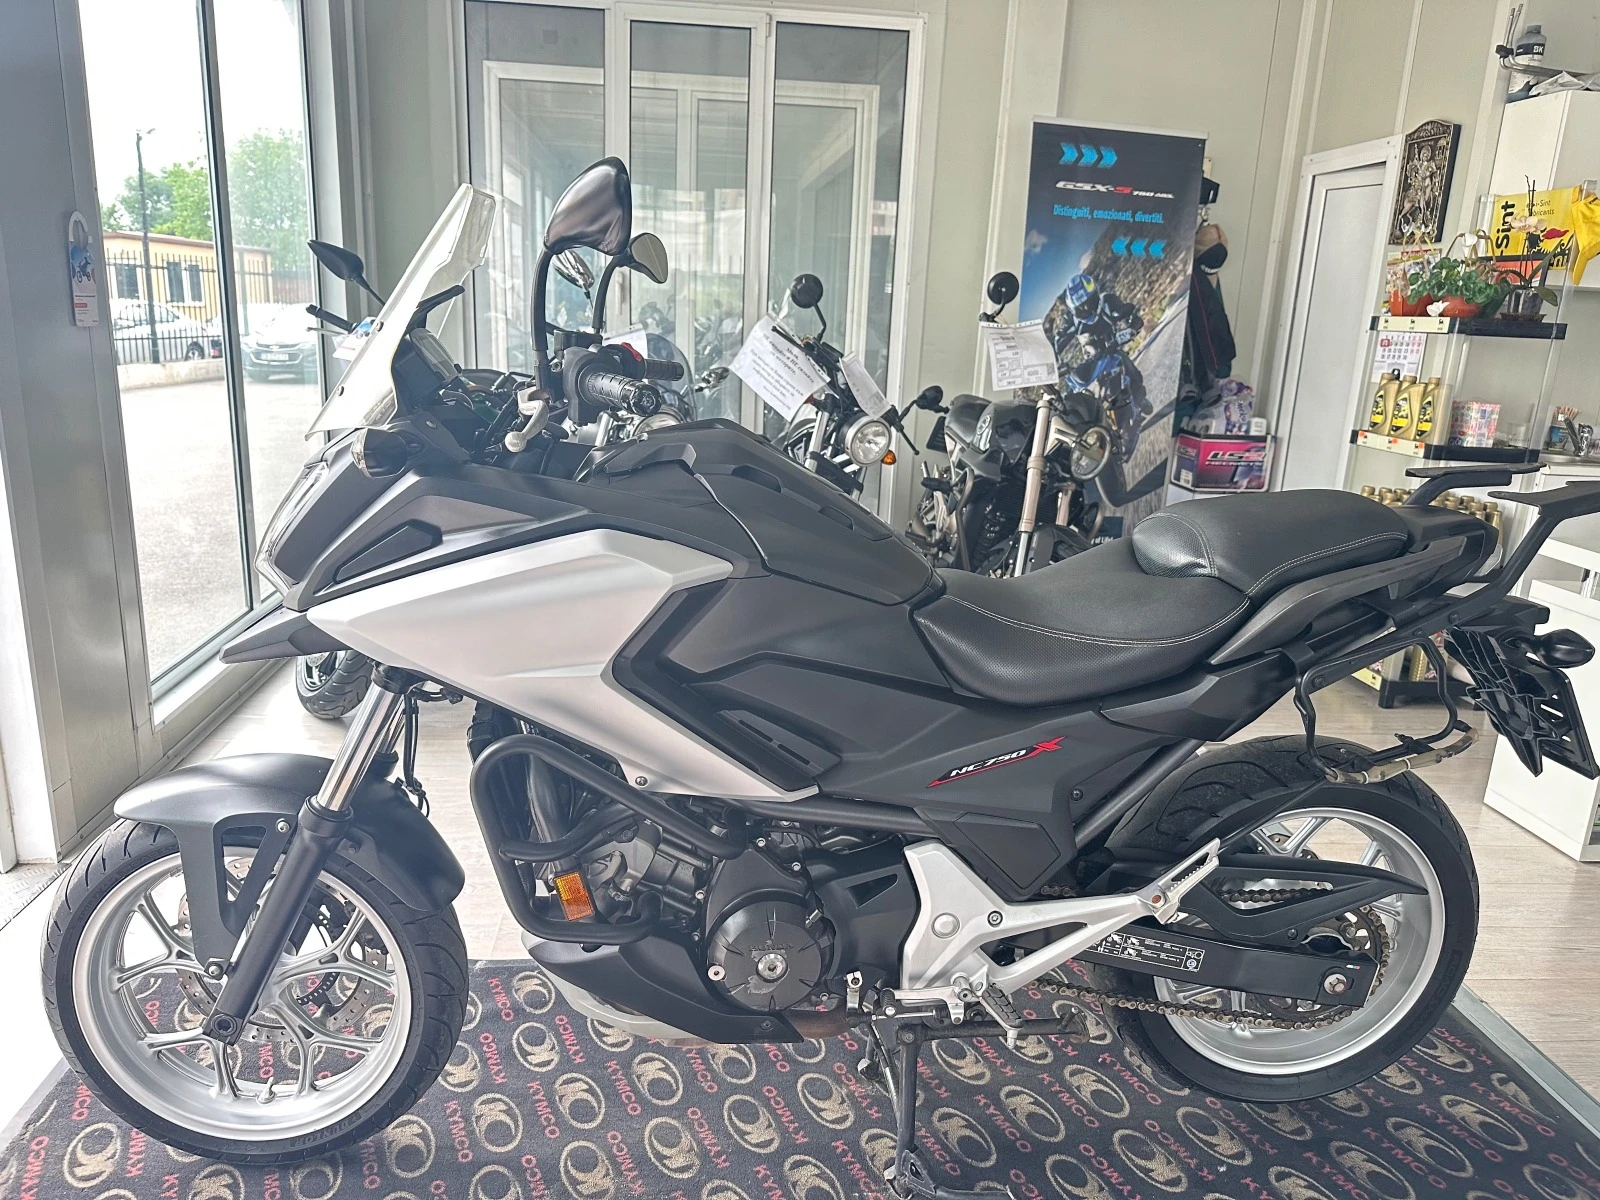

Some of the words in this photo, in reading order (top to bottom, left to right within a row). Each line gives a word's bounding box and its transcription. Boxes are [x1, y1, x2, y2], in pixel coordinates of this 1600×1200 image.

[1056, 181, 1133, 194] GSX-S
[1053, 204, 1092, 219] Distinguiti,
[1093, 209, 1133, 222] emozionati,
[1134, 211, 1164, 224] divertiti.
[1207, 451, 1264, 460] LS2
[950, 749, 1026, 777] NC750
[488, 978, 514, 1021] KYMCO
[259, 1043, 274, 1079] MCO
[480, 1032, 507, 1083] KYMCO
[555, 1015, 585, 1063] KYMCO
[764, 1043, 790, 1072] MCO
[606, 1060, 641, 1115] KYMCO
[686, 1047, 718, 1093] YMCO
[833, 1062, 882, 1118] KYMCO
[1100, 1052, 1161, 1105] KYMCO
[528, 1080, 559, 1138] KYMCO
[762, 1085, 807, 1143] KYMCO
[974, 1095, 1031, 1152] KYMCO
[1038, 1072, 1099, 1128] KYMCO
[296, 1119, 351, 1146] DUNLOP
[444, 1100, 473, 1162] KYMCO
[687, 1107, 730, 1168] KYMCO
[917, 1122, 960, 1176] YMCO
[1145, 1119, 1215, 1182] KYMCO
[607, 1131, 645, 1193] KYMCO
[753, 1164, 785, 1200] KYM
